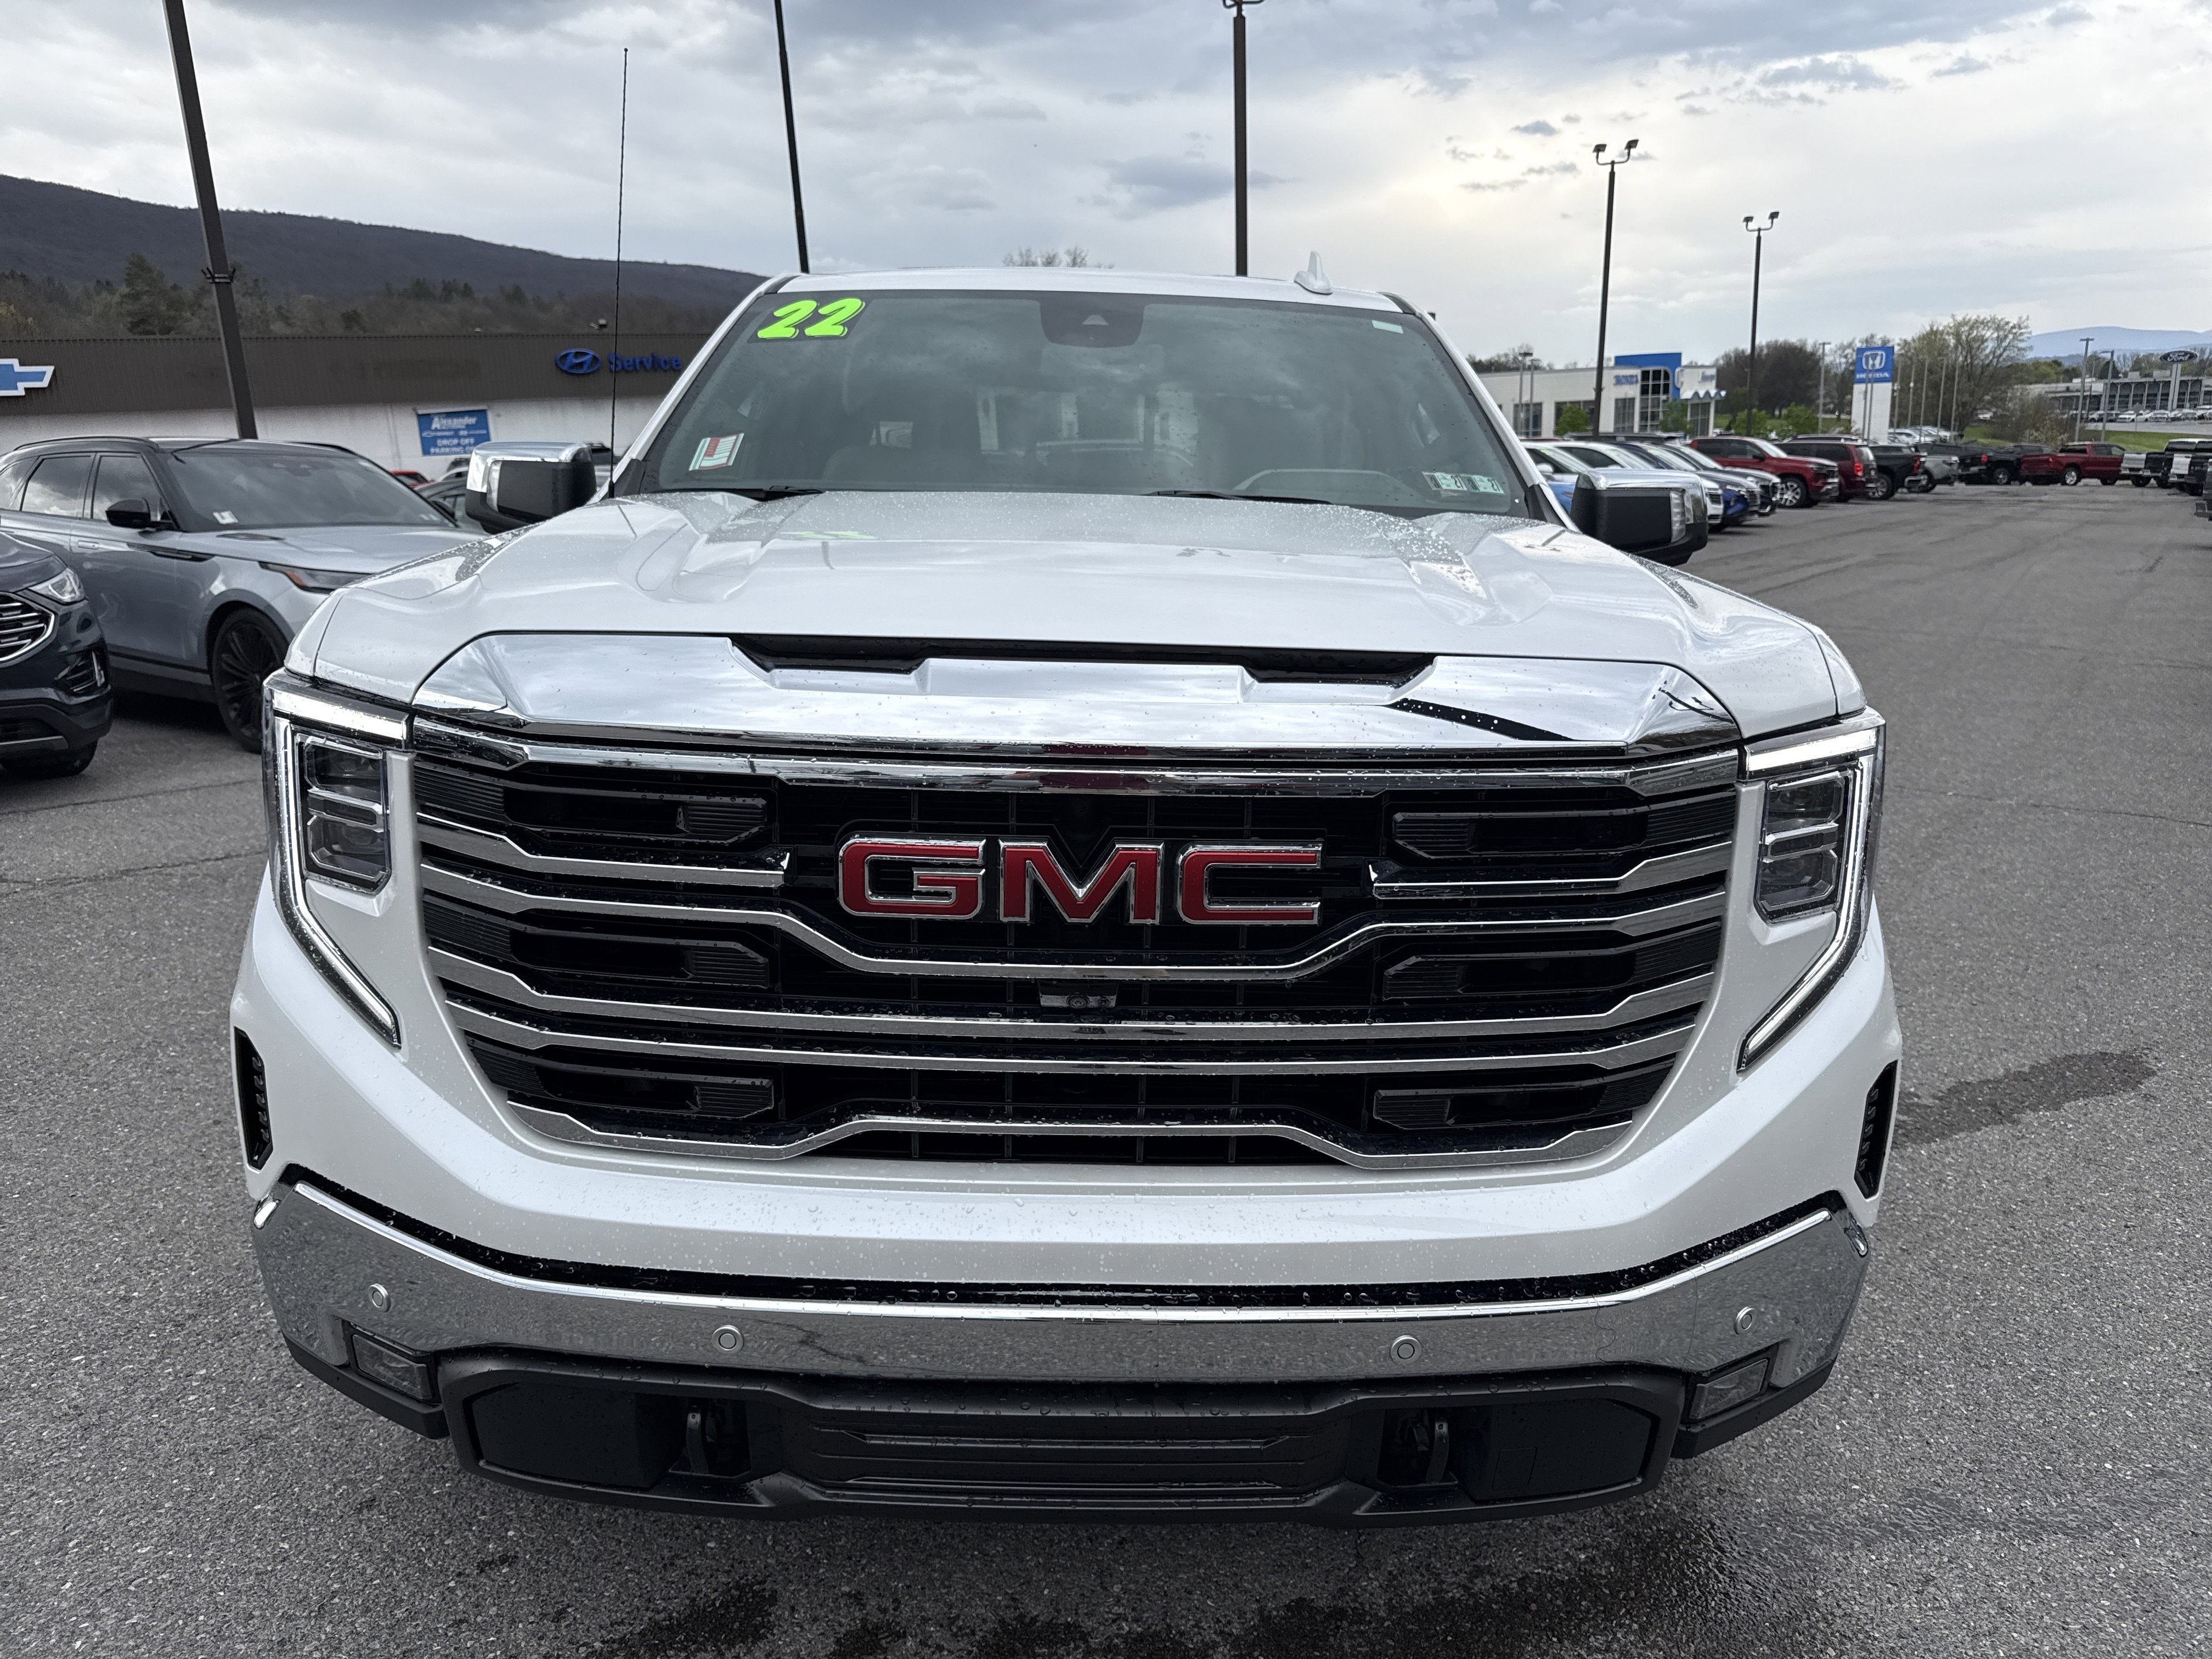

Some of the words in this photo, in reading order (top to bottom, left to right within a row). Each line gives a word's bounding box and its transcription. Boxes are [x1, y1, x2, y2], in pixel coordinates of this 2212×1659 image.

[757, 298, 865, 339] 22
[608, 352, 682, 372] Service
[838, 837, 1323, 926] GMC
